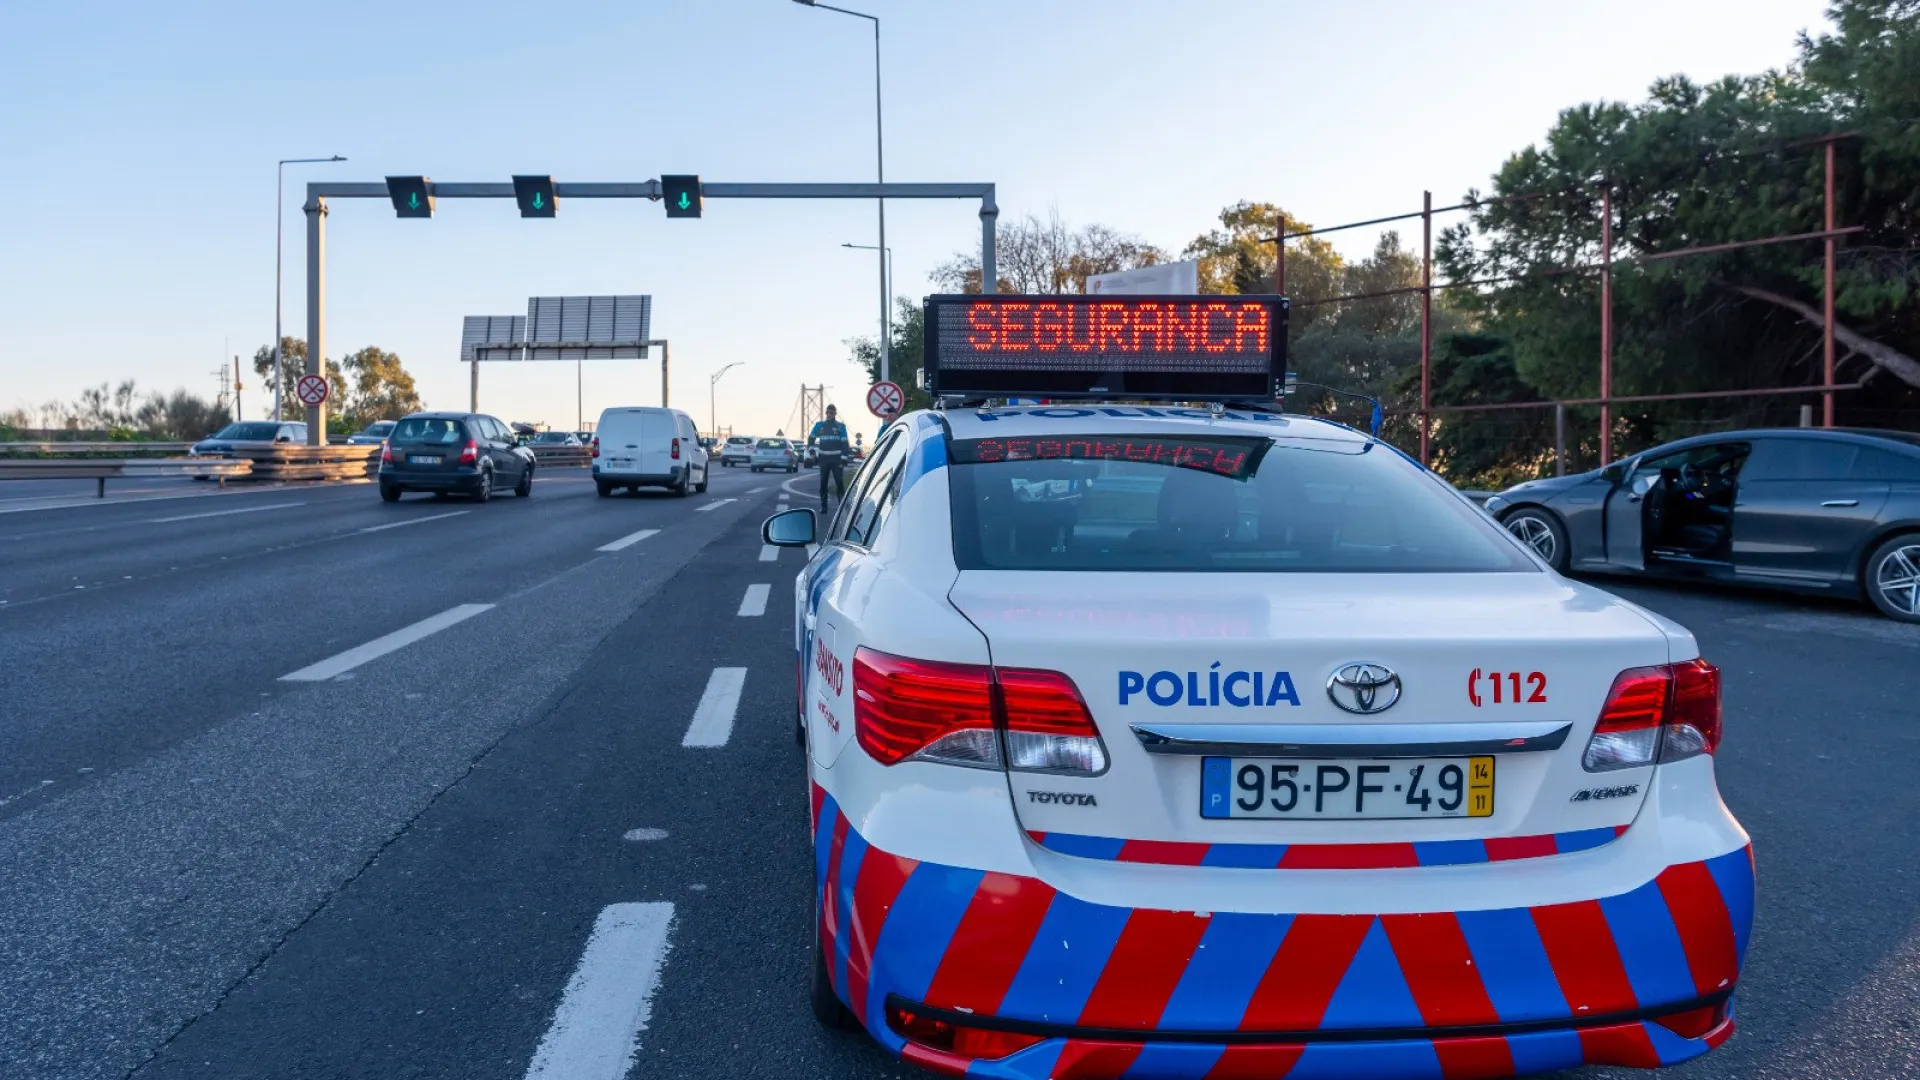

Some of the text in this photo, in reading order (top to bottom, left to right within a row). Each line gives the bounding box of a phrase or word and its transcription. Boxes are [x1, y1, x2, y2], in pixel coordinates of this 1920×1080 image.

[967, 303, 1268, 353] SEGURANCA
[1119, 661, 1301, 707] POLÍCIA
[1488, 671, 1547, 704] 112
[1475, 764, 1488, 780] 14
[1027, 790, 1098, 807] TOYOTA
[1475, 794, 1486, 810] 11
